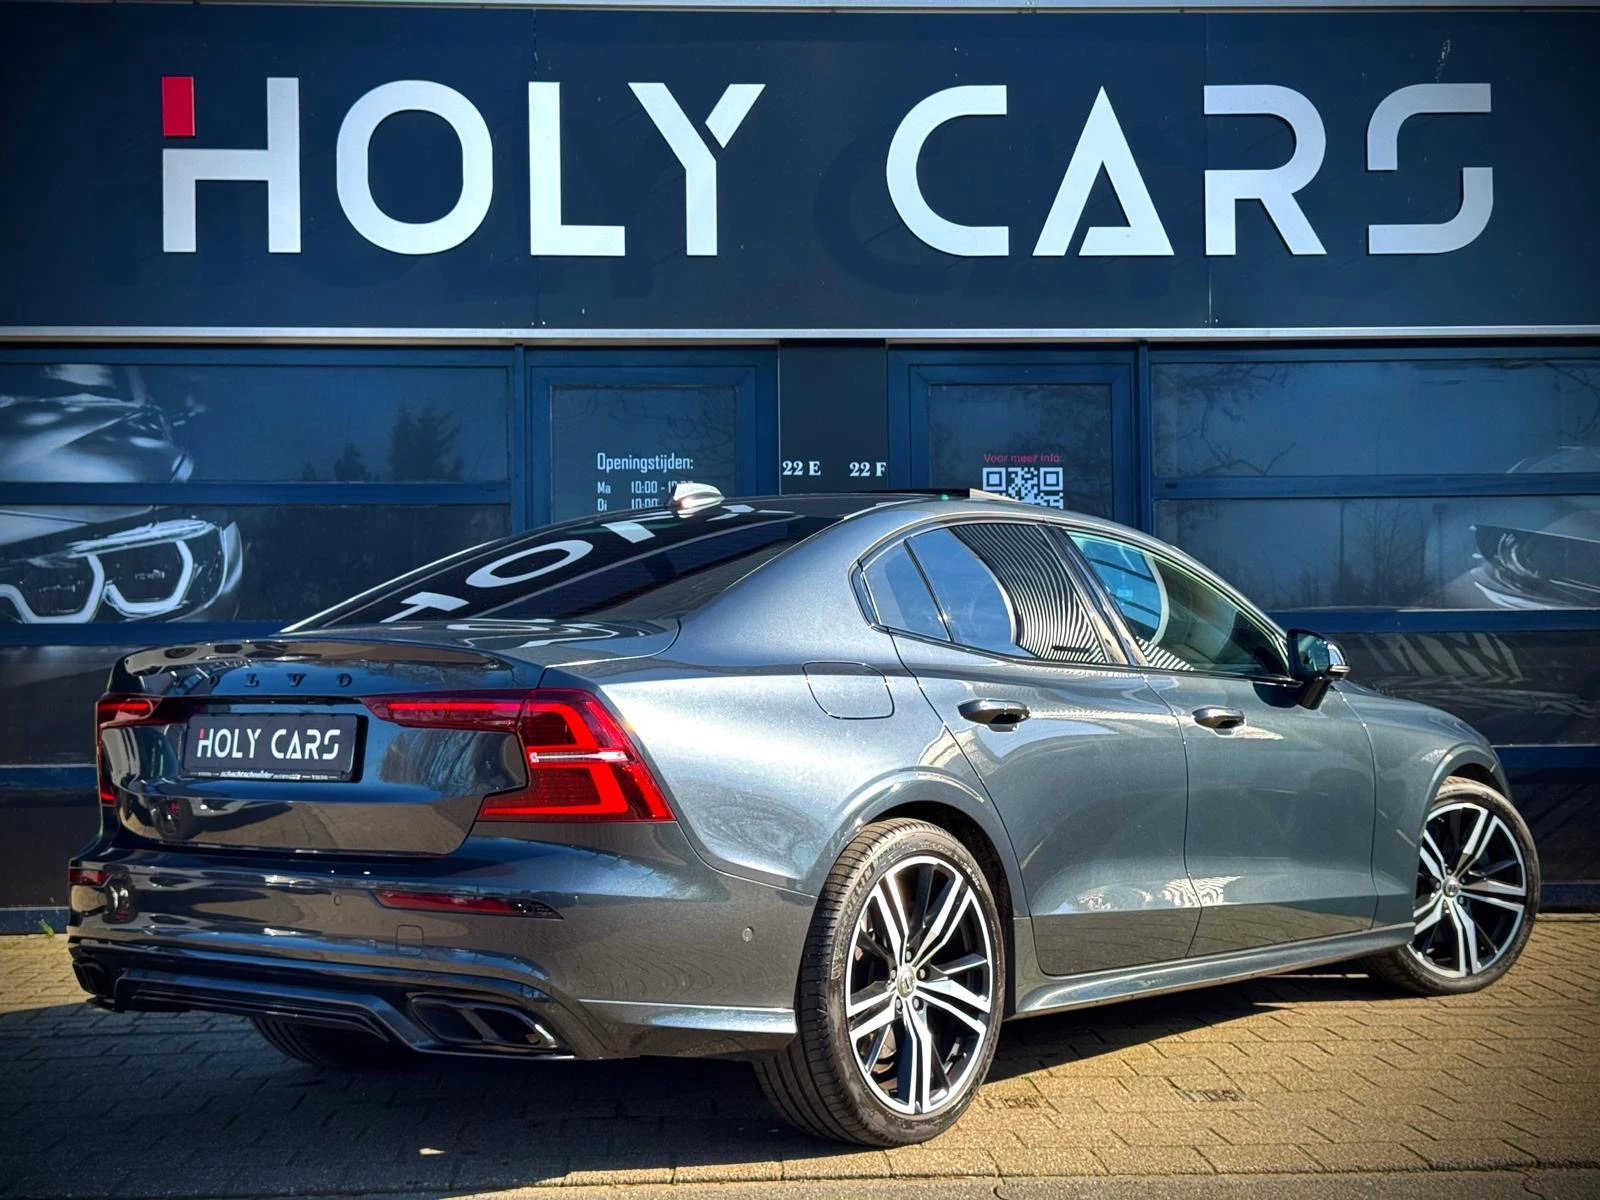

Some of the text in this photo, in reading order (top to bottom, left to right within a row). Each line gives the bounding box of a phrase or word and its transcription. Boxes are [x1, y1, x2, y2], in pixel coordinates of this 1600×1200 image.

[161, 76, 1493, 257] HOLY CARS
[596, 452, 694, 474] Openingstijden:
[983, 453, 1008, 464] Voor
[1010, 454, 1038, 464] meer
[782, 460, 821, 476] 22 E
[849, 461, 887, 477] 22 F
[597, 481, 611, 494] Ma
[631, 481, 658, 494] 10:00
[597, 498, 608, 511] Di
[197, 727, 341, 760] HOLY CARS
